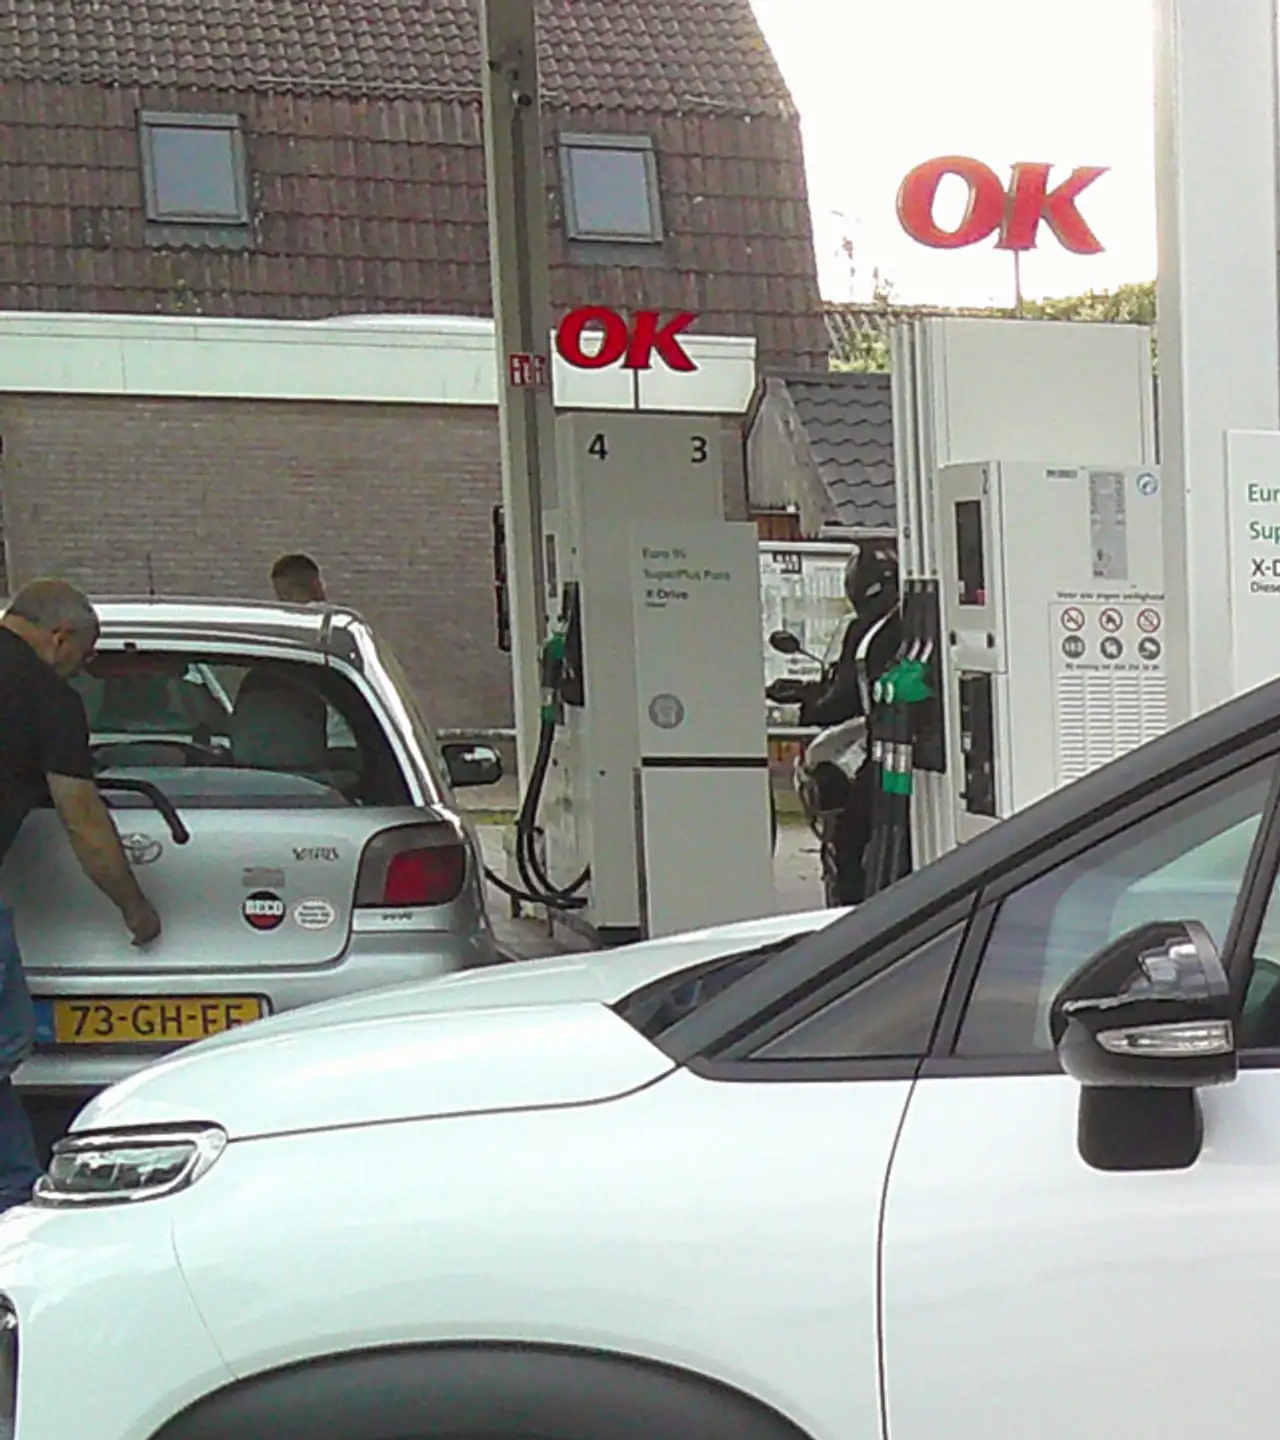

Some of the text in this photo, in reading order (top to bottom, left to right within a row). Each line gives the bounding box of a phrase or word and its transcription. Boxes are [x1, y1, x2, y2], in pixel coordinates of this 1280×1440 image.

[896, 155, 1111, 255] OK
[556, 306, 699, 372] OK
[588, 433, 608, 460] 4
[690, 436, 707, 464] 3
